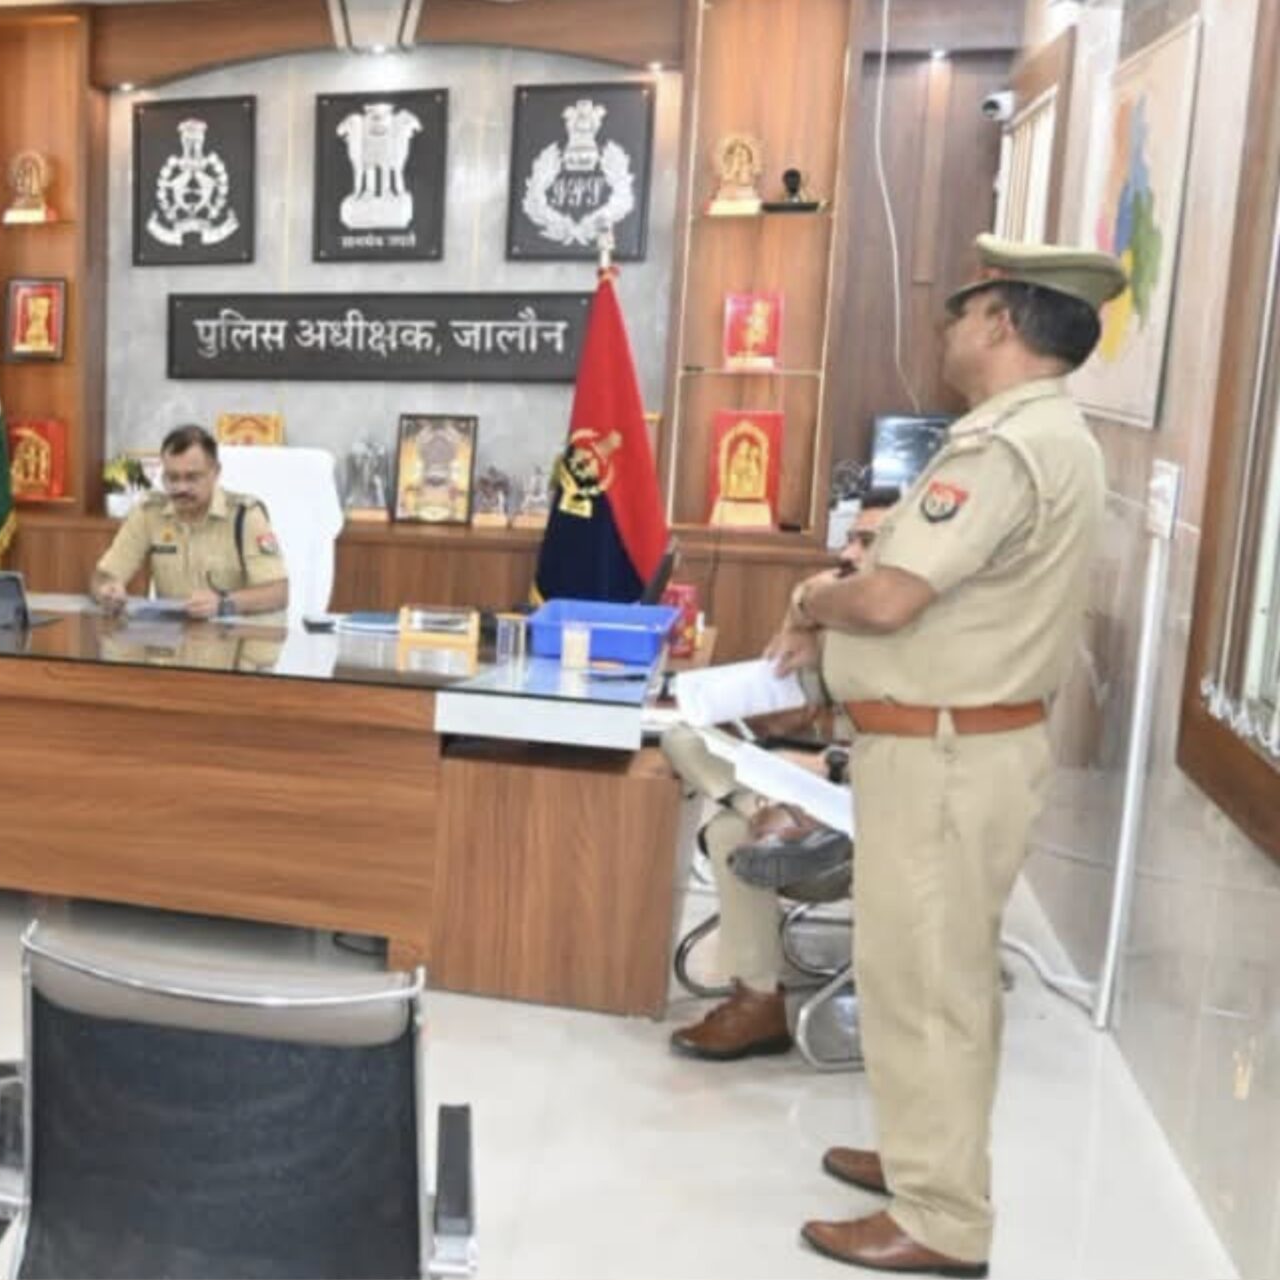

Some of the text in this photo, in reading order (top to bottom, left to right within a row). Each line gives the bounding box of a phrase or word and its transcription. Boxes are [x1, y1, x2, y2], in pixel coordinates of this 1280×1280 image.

[194, 306, 569, 358] पुलिस अधीक्षक, जालौन
